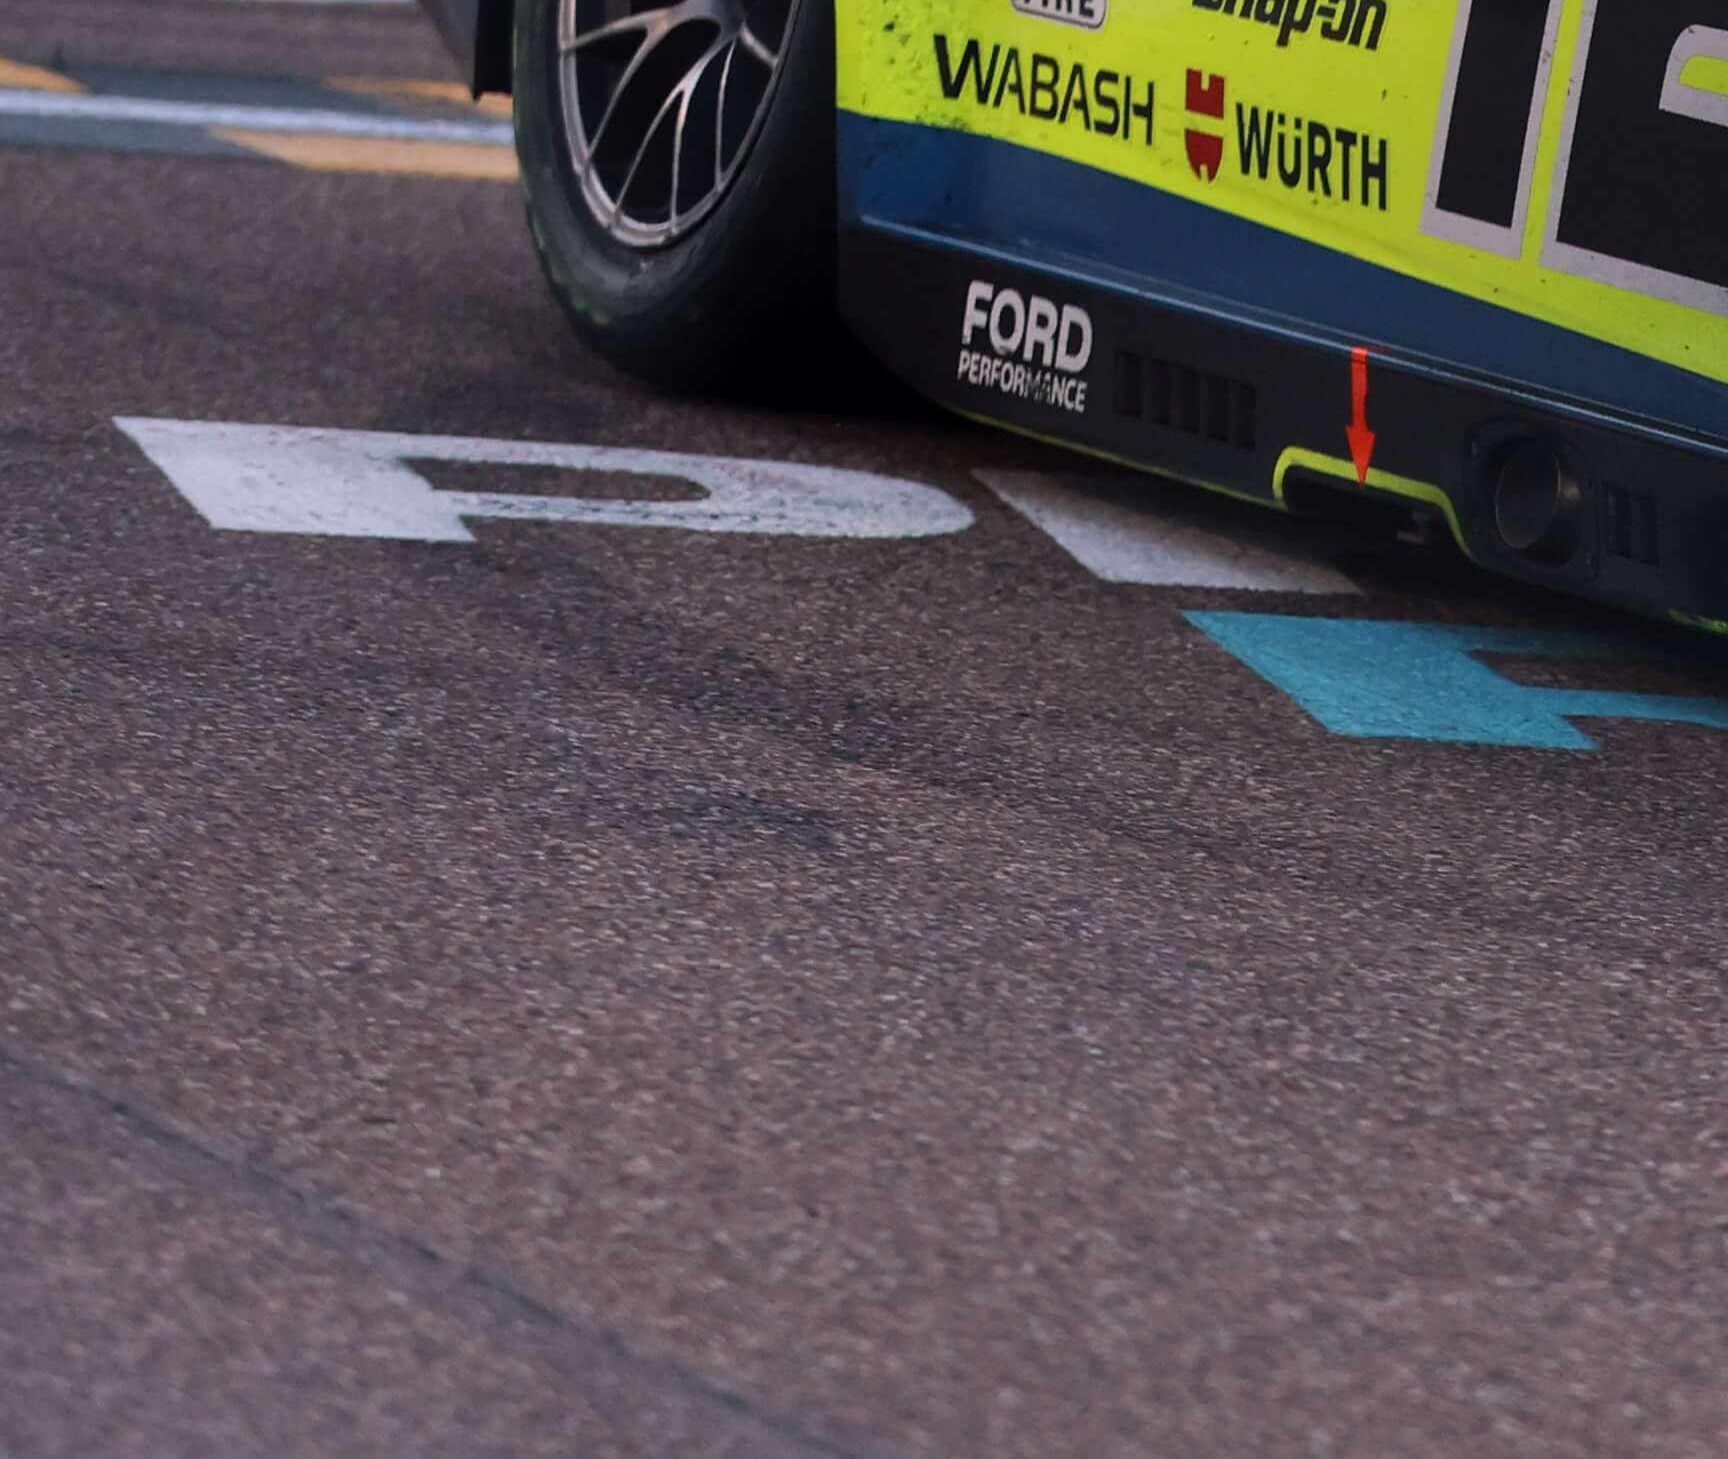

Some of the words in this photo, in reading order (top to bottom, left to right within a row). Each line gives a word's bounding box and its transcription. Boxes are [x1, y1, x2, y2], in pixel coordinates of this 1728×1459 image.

[934, 33, 1156, 145] WABASH
[1236, 102, 1388, 211] WÜRTH
[961, 279, 1093, 372] FORD
